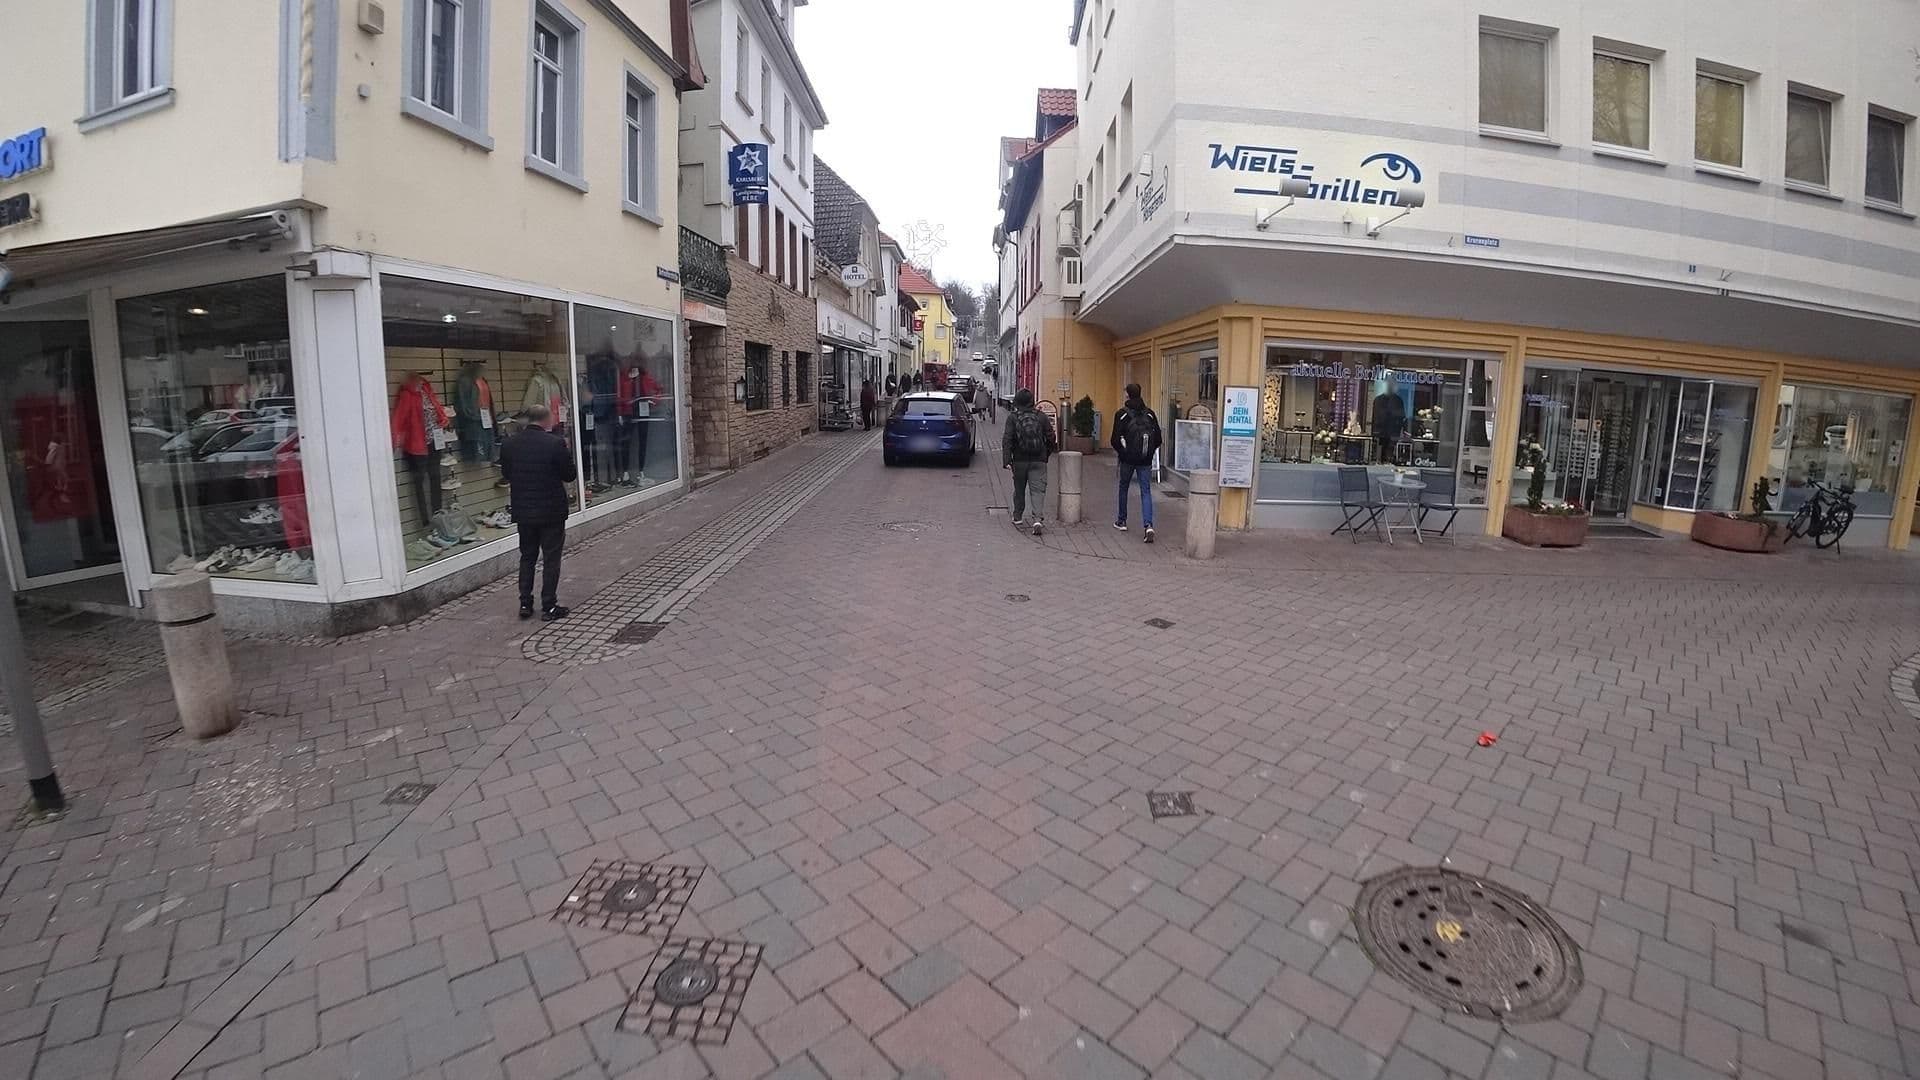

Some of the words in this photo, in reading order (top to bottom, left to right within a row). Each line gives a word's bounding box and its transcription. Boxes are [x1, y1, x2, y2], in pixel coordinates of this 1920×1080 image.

[1208, 144, 1315, 175] Wiels-
[844, 273, 866, 281] HOTEL
[1291, 360, 1352, 380] aktuelle
[1354, 364, 1445, 385] Brillnmode
[1232, 407, 1249, 416] DEIN
[1227, 416, 1253, 425] DENTAL
